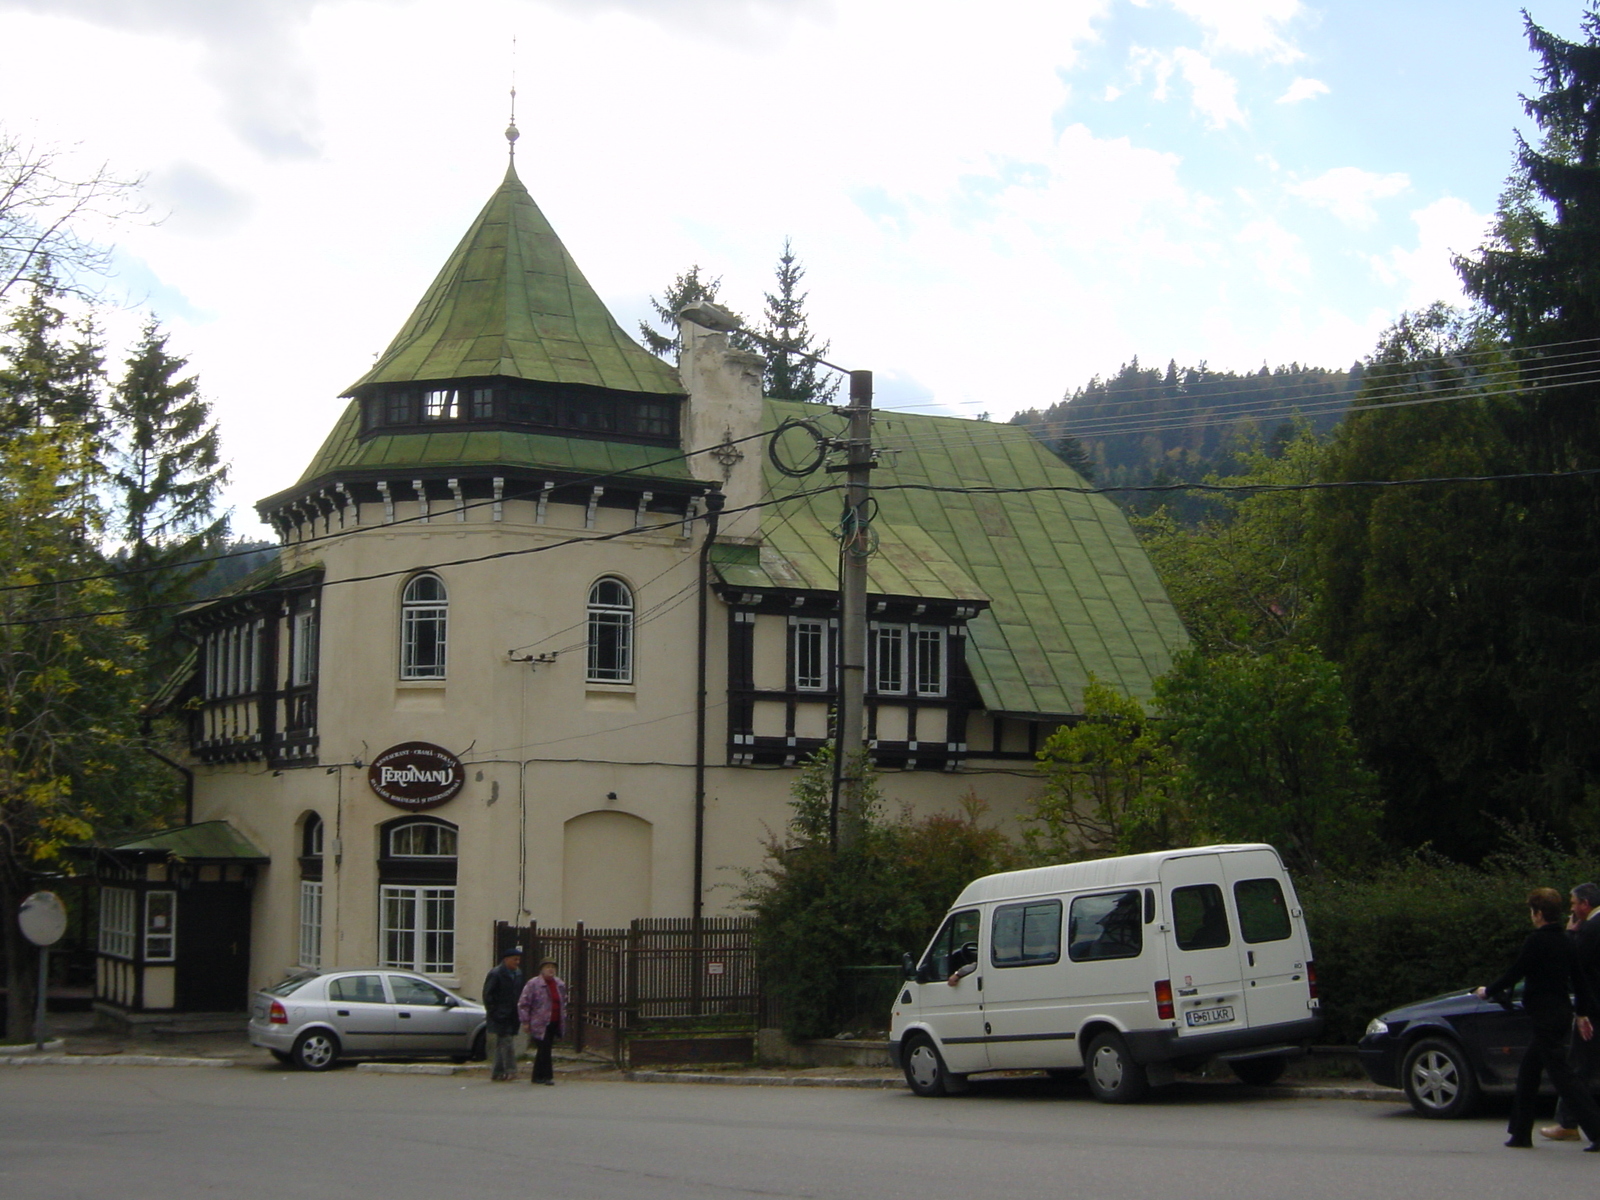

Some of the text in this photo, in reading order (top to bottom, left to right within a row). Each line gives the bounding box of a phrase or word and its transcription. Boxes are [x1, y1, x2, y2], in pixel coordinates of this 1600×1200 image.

[375, 749, 410, 767] RESTAURANT
[380, 764, 454, 787] FERDINAND
[1212, 1008, 1229, 1020] LKR
